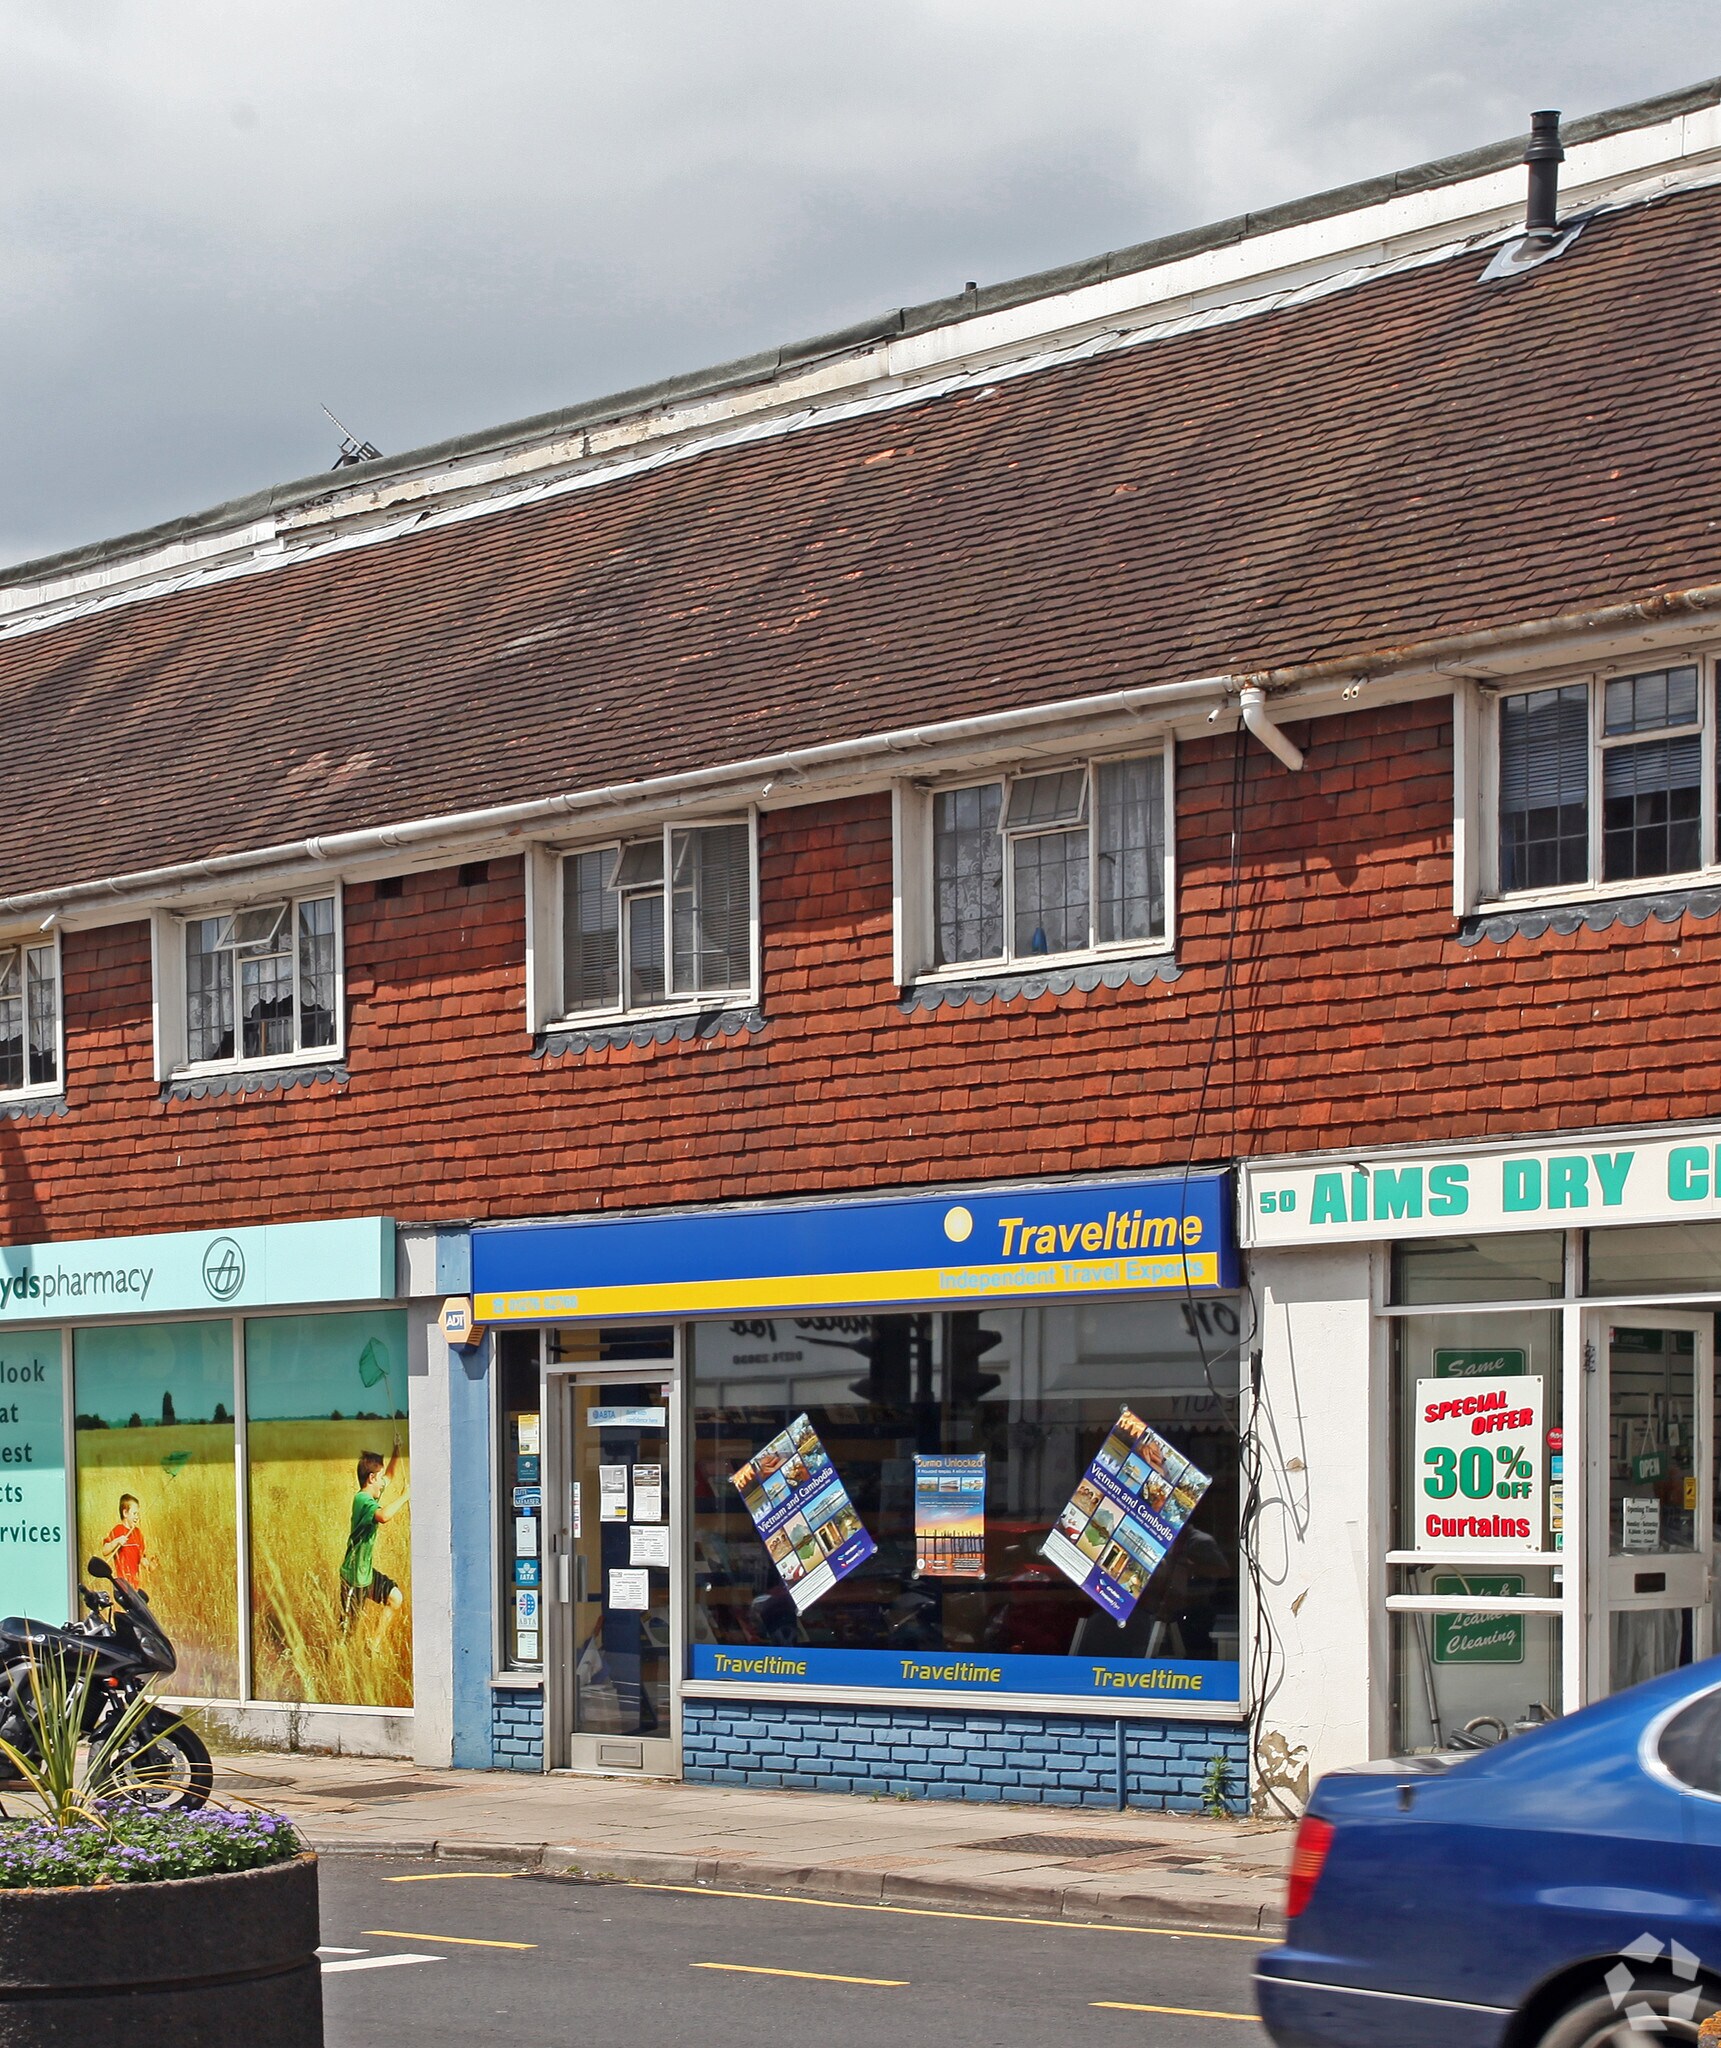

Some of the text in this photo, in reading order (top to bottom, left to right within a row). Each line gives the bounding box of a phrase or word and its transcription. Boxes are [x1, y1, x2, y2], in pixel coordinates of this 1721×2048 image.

[1259, 1146, 1721, 1225] 50 AIMS DRY C
[998, 1209, 1203, 1256] Traveltime
[940, 1259, 1203, 1291] Independent Travel Experts
[446, 1313, 465, 1328] ADT
[0, 1359, 44, 1383] look
[1448, 1355, 1505, 1377] Same
[599, 1411, 616, 1419] ABTA
[1424, 1390, 1509, 1423] SPECIAL
[1471, 1407, 1534, 1436] OFFER
[945, 1458, 983, 1467] Unlocked
[1423, 1445, 1533, 1500] 30%
[1639, 1458, 1660, 1479] OPEN
[515, 1498, 541, 1506] MEMBER
[758, 1507, 787, 1532] Vietnam
[787, 1496, 800, 1511] and
[799, 1467, 834, 1498] Cambodia
[1091, 1463, 1174, 1542] Vietnam and Cambodia
[1496, 1482, 1533, 1499] OFF
[1425, 1514, 1531, 1538] Curtains
[519, 1573, 534, 1581] IATA
[518, 1617, 537, 1626] ABTA
[1446, 1629, 1517, 1654] Cleaning
[713, 1653, 1203, 1691] Traveltime Traveltime Traveltime
